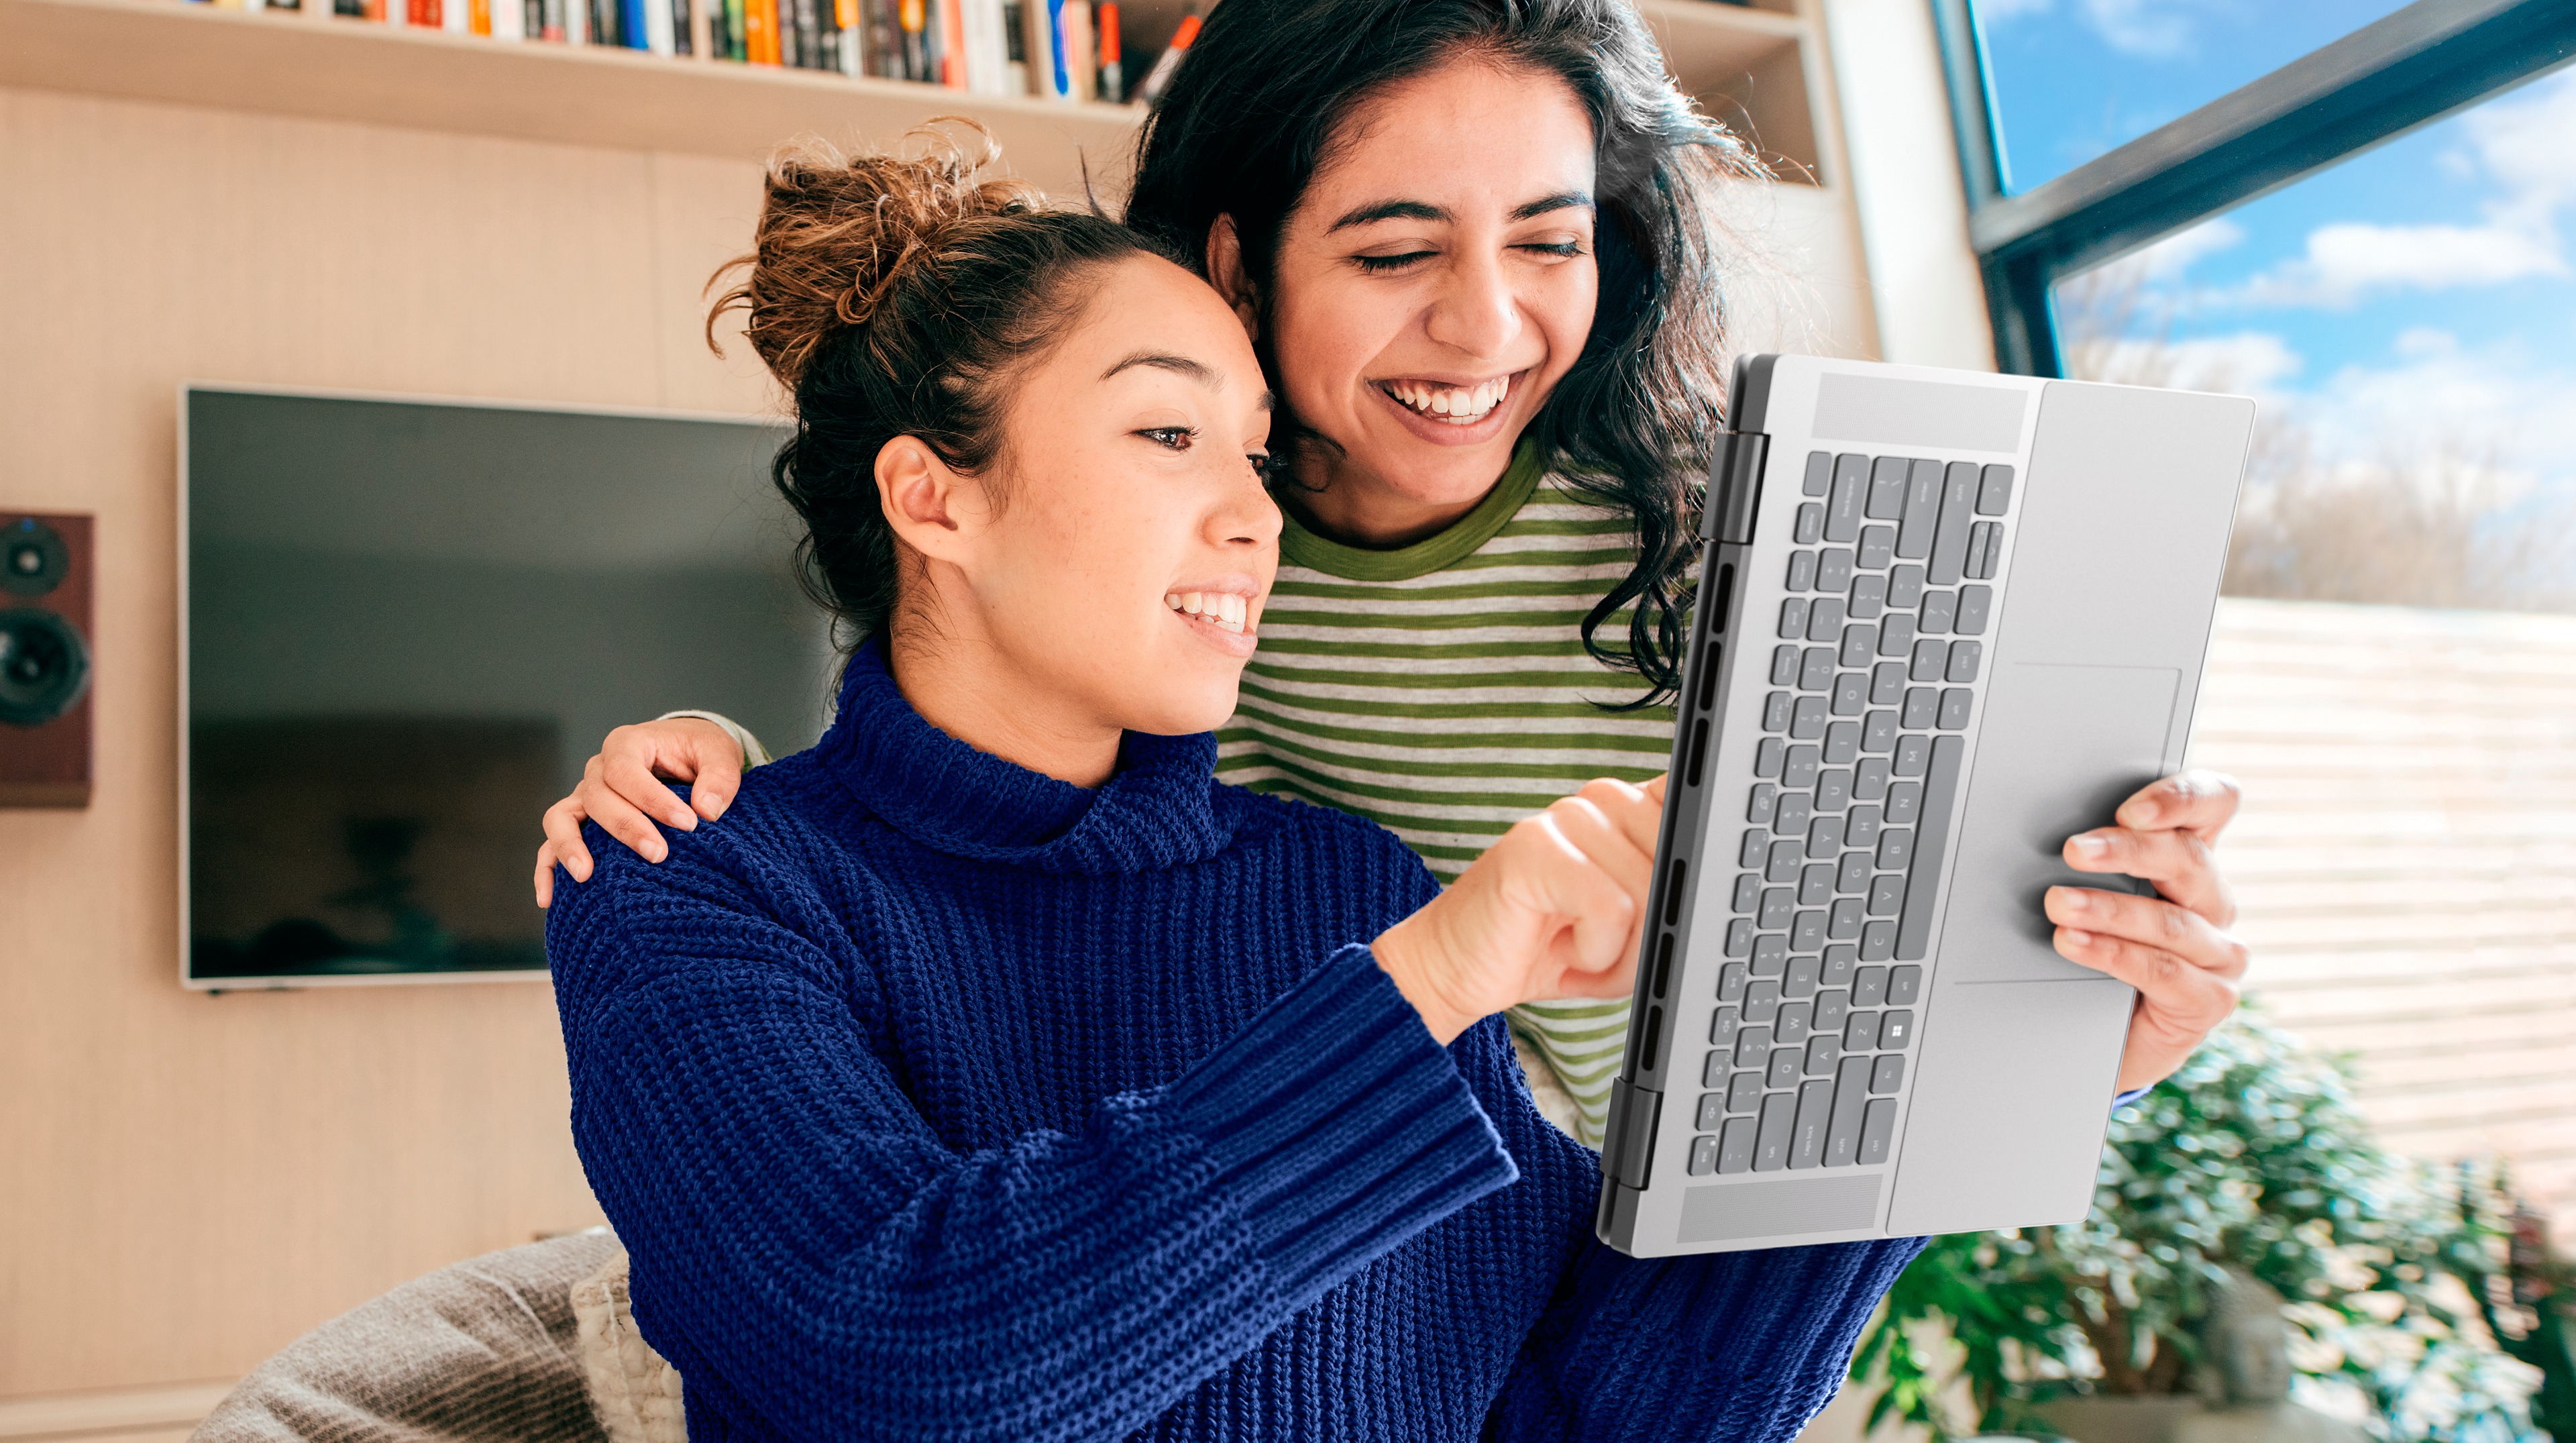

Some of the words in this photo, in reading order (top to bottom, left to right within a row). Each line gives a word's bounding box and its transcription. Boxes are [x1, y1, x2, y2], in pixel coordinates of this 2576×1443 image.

[1955, 483, 1965, 502] shift
[1854, 641, 1865, 652] P
[1961, 655, 1969, 670] ctrl
[1820, 665, 1831, 675] 0
[1884, 681, 1896, 689] L
[1845, 689, 1858, 701] O
[1952, 704, 1960, 716] alt
[1812, 714, 1823, 723] 9
[1876, 728, 1887, 737] K
[1907, 750, 1918, 763] M
[1803, 762, 1815, 771] 8
[1868, 775, 1879, 783] J
[1829, 786, 1841, 796] U
[1898, 798, 1910, 808] N
[1860, 821, 1870, 832] H
[1821, 834, 1832, 843] Y
[1890, 845, 1902, 855] B
[1787, 857, 1798, 867] 6
[1851, 867, 1863, 879] G
[1813, 881, 1824, 890] T
[1882, 891, 1892, 901] V
[1779, 904, 1790, 913] 5
[1842, 916, 1853, 924] F
[1805, 926, 1816, 937] R
[1874, 938, 1885, 947] C
[1834, 960, 1845, 971] D
[1796, 974, 1809, 983] E
[1866, 983, 1876, 992] X
[1901, 981, 1909, 992] alt
[1826, 1006, 1838, 1015] S
[1789, 1017, 1801, 1030] W
[1857, 1028, 1868, 1036] Z
[1756, 1043, 1766, 1051] 2
[1819, 1051, 1829, 1061] A
[1781, 1063, 1793, 1074] Q
[1884, 1070, 1892, 1079] fn
[1805, 1126, 1814, 1140] lock
[1803, 1140, 1812, 1157] caps
[1837, 1137, 1846, 1155] shift
[1872, 1139, 1880, 1153] ctrl
[1768, 1145, 1776, 1159] tab
